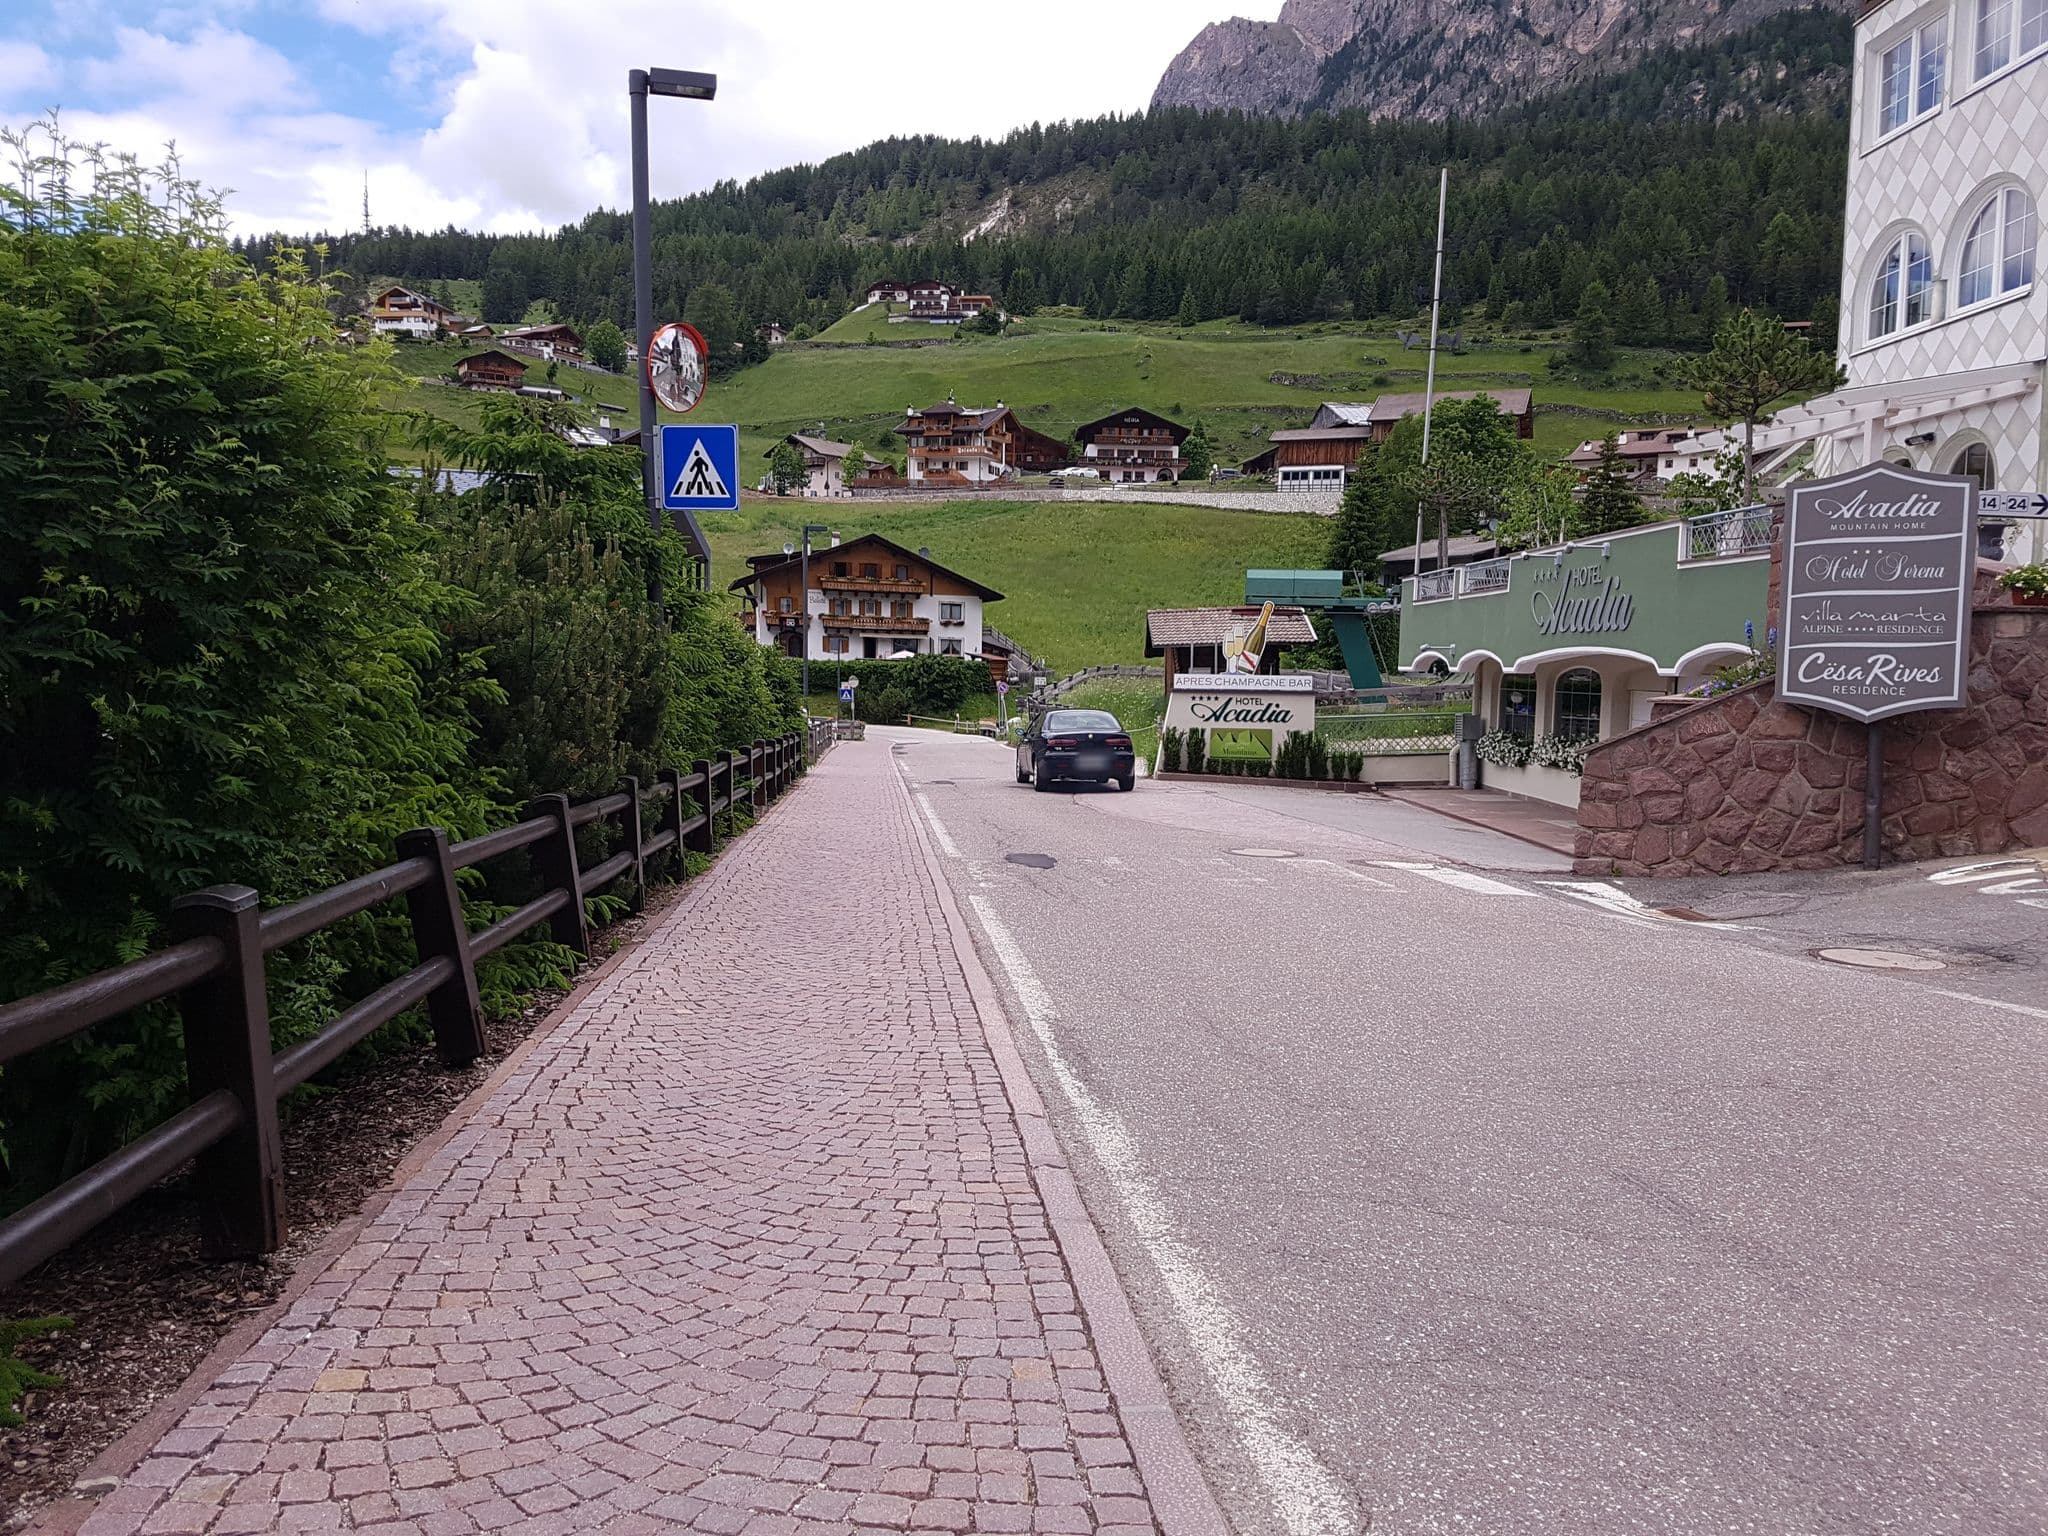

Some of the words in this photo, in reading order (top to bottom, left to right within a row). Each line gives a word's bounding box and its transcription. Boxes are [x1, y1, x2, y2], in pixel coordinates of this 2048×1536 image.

[1814, 489, 1943, 519] Acadia
[1830, 522, 1889, 531] MOUNTAIN
[1894, 521, 1927, 530] HOME
[1572, 564, 1604, 587] HOTEL
[1805, 554, 1869, 583] Hotel
[1874, 551, 1945, 582] Serena
[1531, 568, 1636, 635] Acadia
[1800, 600, 1842, 621] villa
[1849, 606, 1946, 622] marta
[1802, 624, 1844, 634] ALPINE
[1876, 624, 1944, 635] RESIDENCE
[1214, 677, 1286, 688] CHAMPAGNE
[1288, 678, 1312, 688] BAR
[1832, 685, 1907, 696] RESIDENCE
[1190, 697, 1294, 724] Acadia
[1235, 697, 1265, 706] HOTEL
